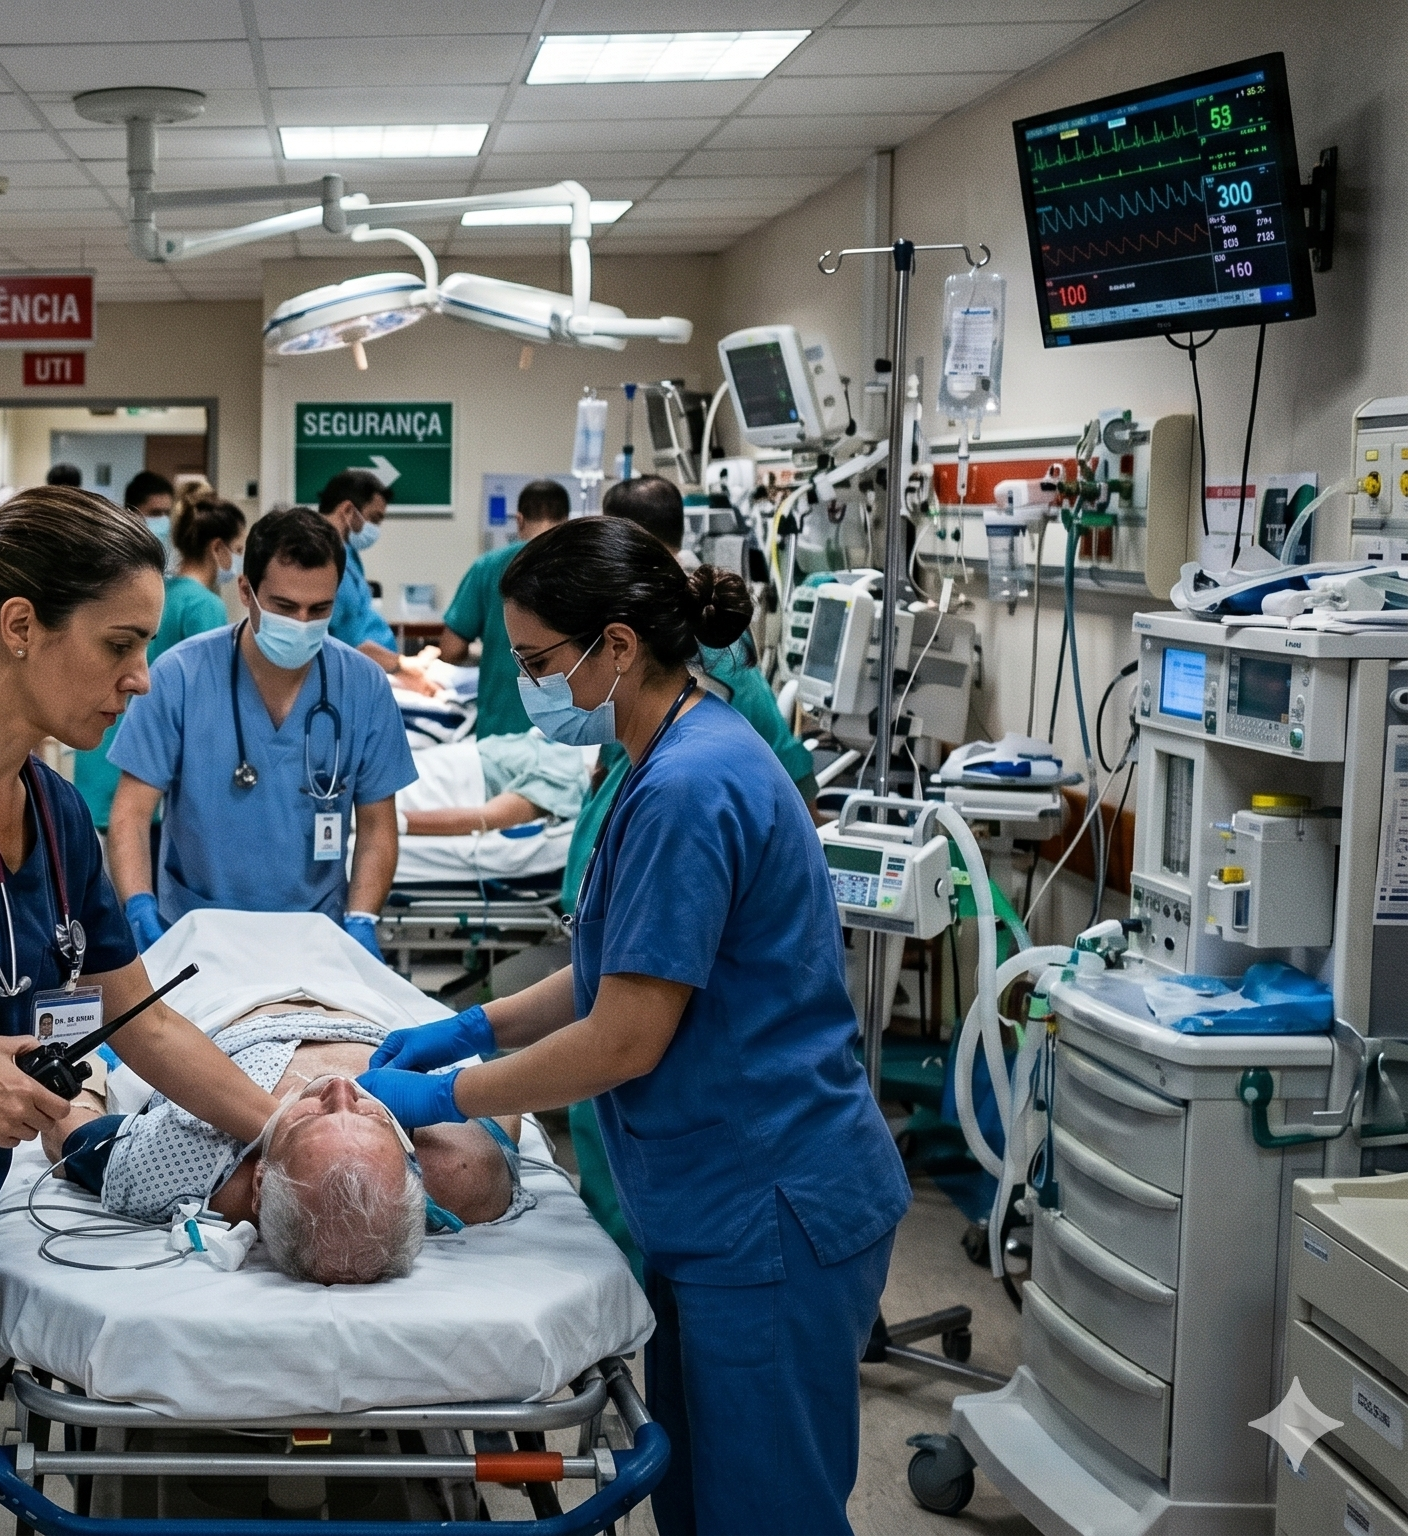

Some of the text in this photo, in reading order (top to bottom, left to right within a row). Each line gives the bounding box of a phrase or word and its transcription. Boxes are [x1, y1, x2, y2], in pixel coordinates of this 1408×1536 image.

[1216, 181, 1252, 208] 300
[1059, 284, 1087, 307] 100
[35, 357, 72, 381] UTI
[303, 411, 443, 442] SEGURANÇA
